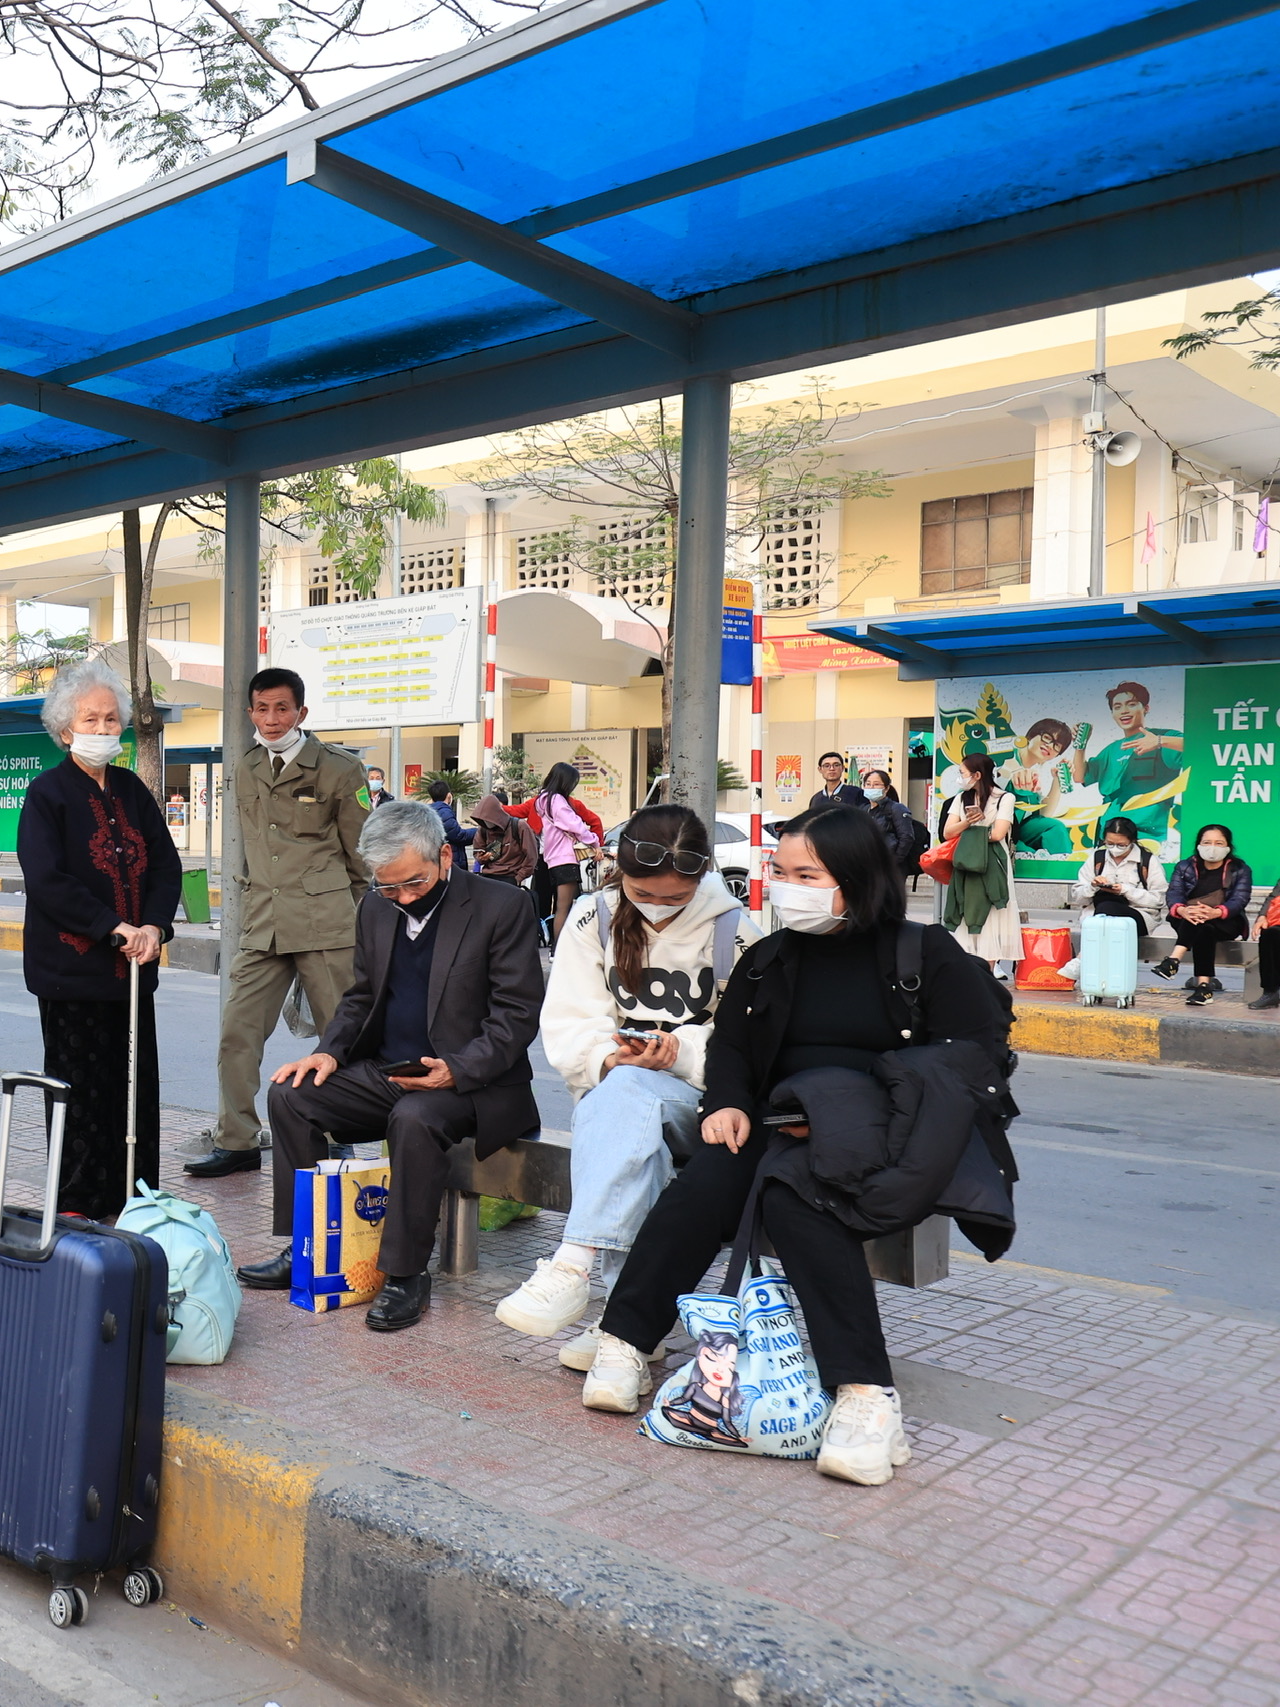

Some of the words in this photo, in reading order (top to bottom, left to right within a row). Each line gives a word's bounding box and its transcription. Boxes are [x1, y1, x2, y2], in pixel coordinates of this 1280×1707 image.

[1213, 698, 1269, 731] TẾT
[10, 757, 43, 771] SPRITE,
[1212, 743, 1275, 771] VẠN
[12, 773, 29, 789] HOÁ
[1211, 773, 1271, 803] TÂN
[769, 1313, 795, 1331] NOT
[772, 1332, 799, 1351] AND
[760, 1417, 797, 1435] SAGE
[780, 1435, 808, 1449] AND
